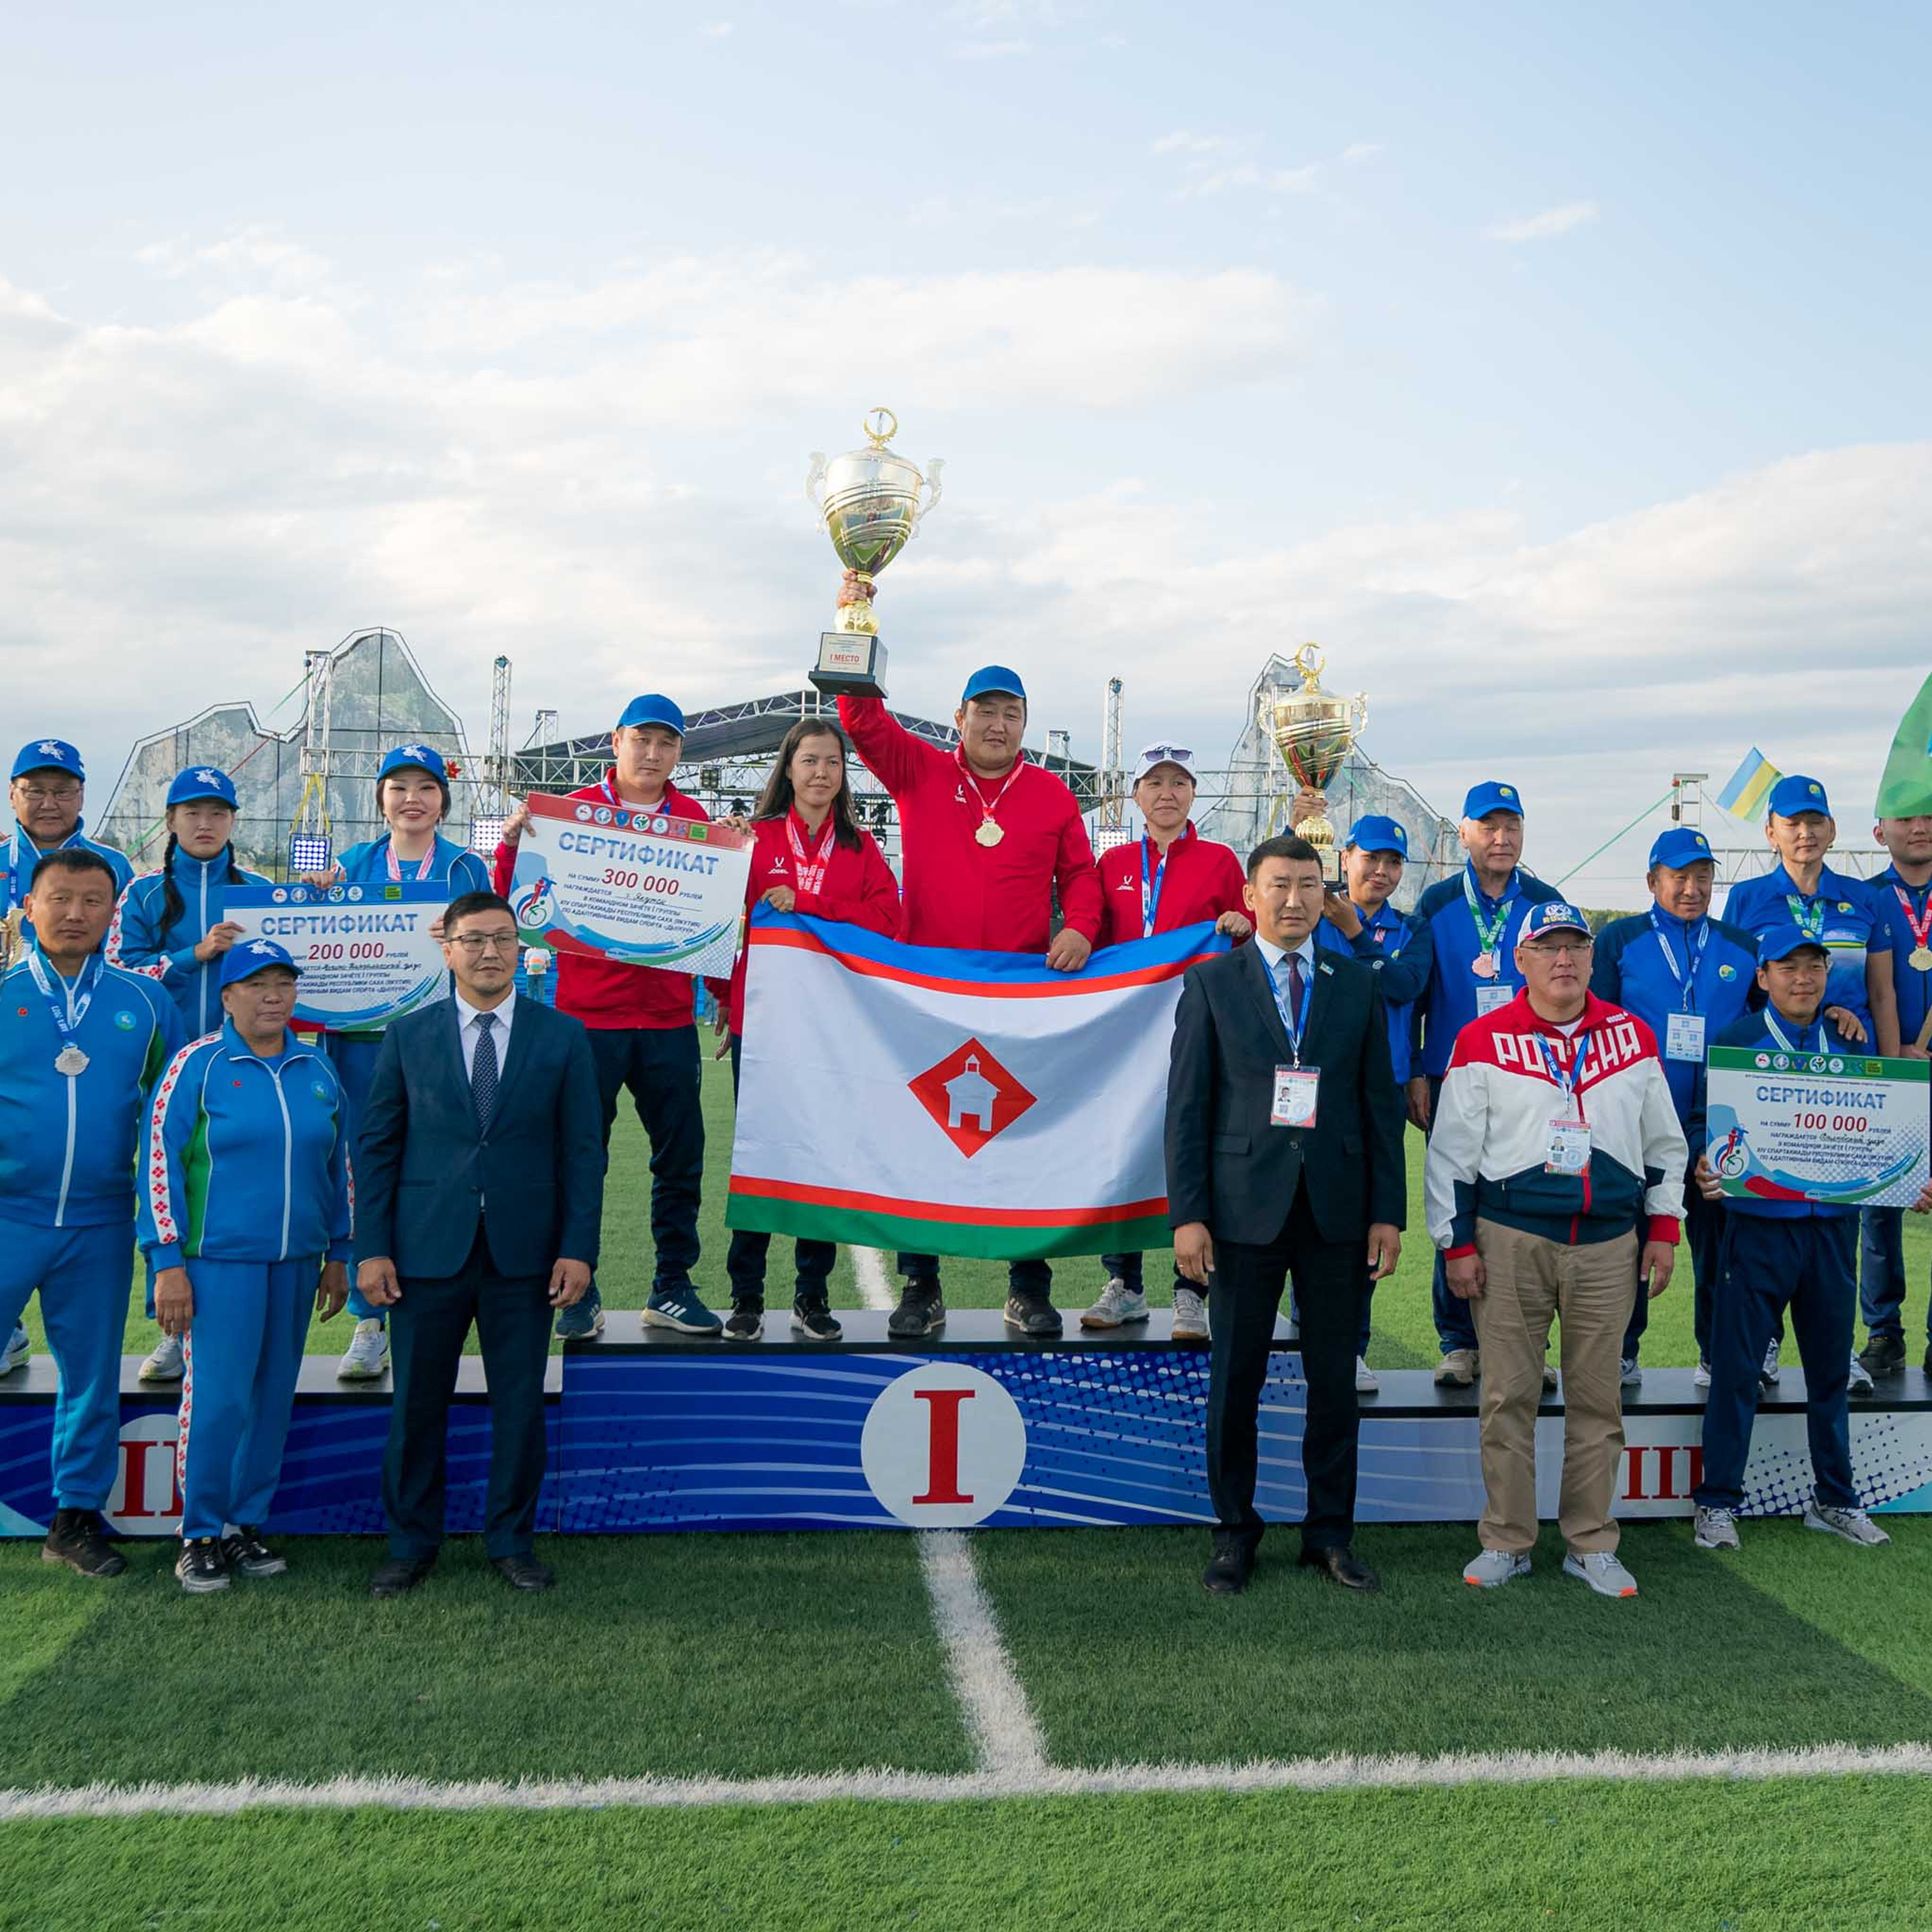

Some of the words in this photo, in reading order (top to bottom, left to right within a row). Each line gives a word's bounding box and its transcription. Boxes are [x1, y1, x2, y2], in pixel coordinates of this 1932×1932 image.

[834, 654, 860, 663] МЕСТО
[558, 832, 719, 875] СЕРТИФИКАТ
[563, 883, 613, 896] НАГРАЖДАЕТСЯ
[601, 869, 638, 888] 300
[644, 875, 679, 895] 000
[260, 913, 418, 936] СЕРТИФИКАТ
[309, 944, 343, 960] 200
[349, 943, 384, 959] 000
[1492, 1022, 1641, 1084] РОССИЯ
[1755, 1086, 1887, 1109] СЕРТИФИКАТ
[1794, 1113, 1826, 1129] 100
[1832, 1115, 1866, 1132] 000
[912, 1389, 975, 1504] I
